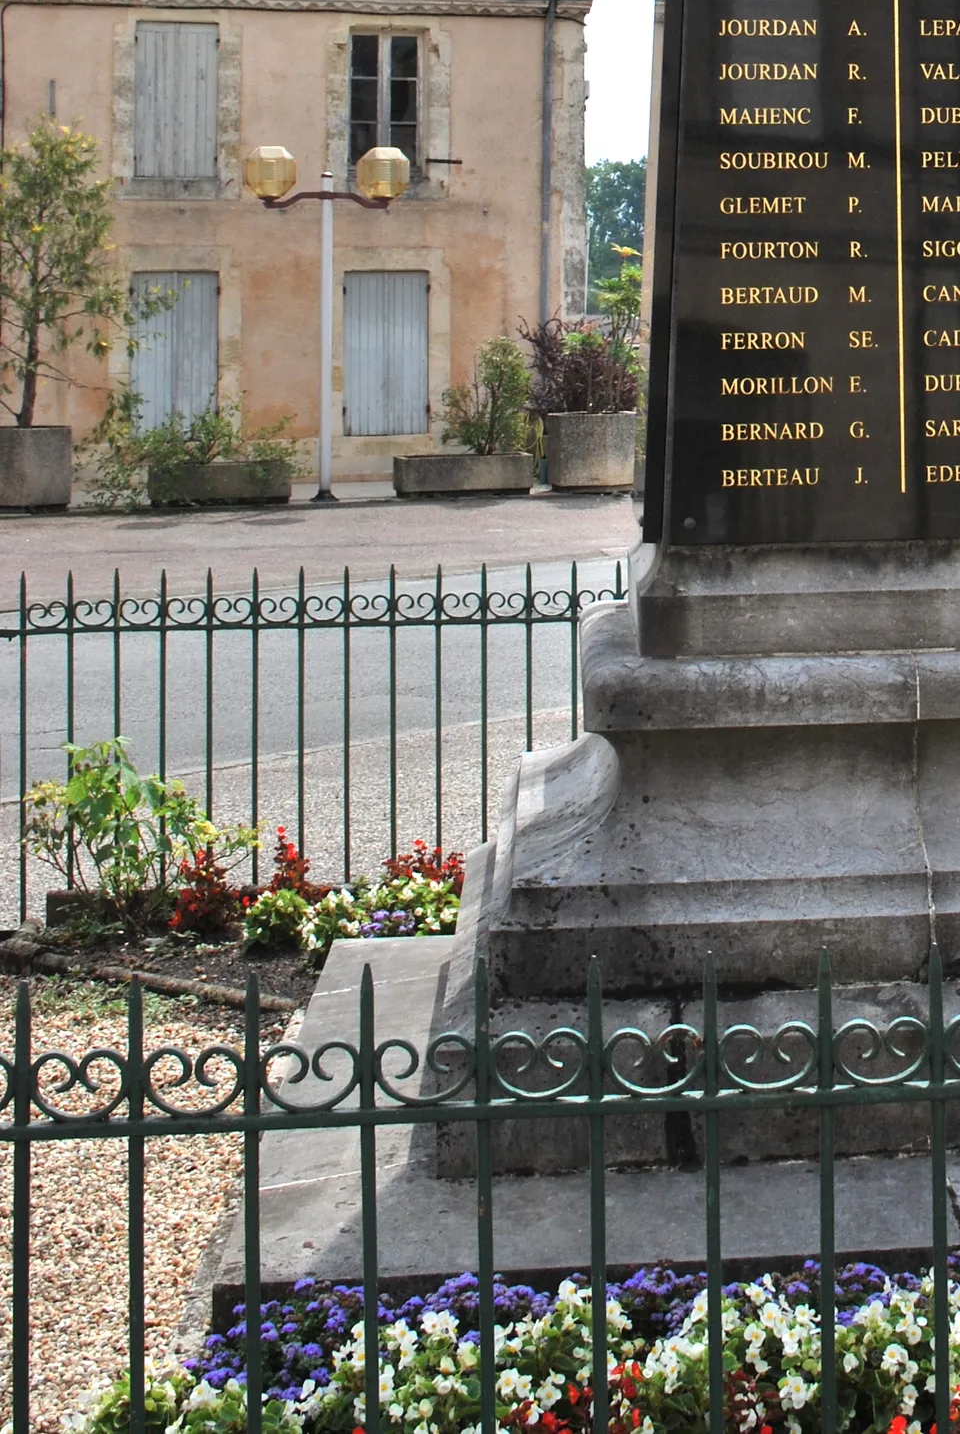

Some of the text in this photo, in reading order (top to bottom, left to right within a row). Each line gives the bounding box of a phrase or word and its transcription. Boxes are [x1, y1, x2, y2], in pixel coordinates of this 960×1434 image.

[719, 19, 867, 36] JOURDAN A.
[719, 63, 867, 81] JOURDAN R.
[720, 107, 862, 125] MAHENC F.
[720, 152, 871, 169] SOUBIROU M.
[720, 196, 862, 214] GLEMET P.
[720, 241, 868, 259] FOURTON R.
[720, 286, 872, 305] BERTAUD M.
[720, 332, 806, 350] FERRON
[721, 376, 867, 395] MORILLON E.
[721, 421, 870, 441] BERNARD G.
[721, 466, 869, 487] BERTEAU J.
